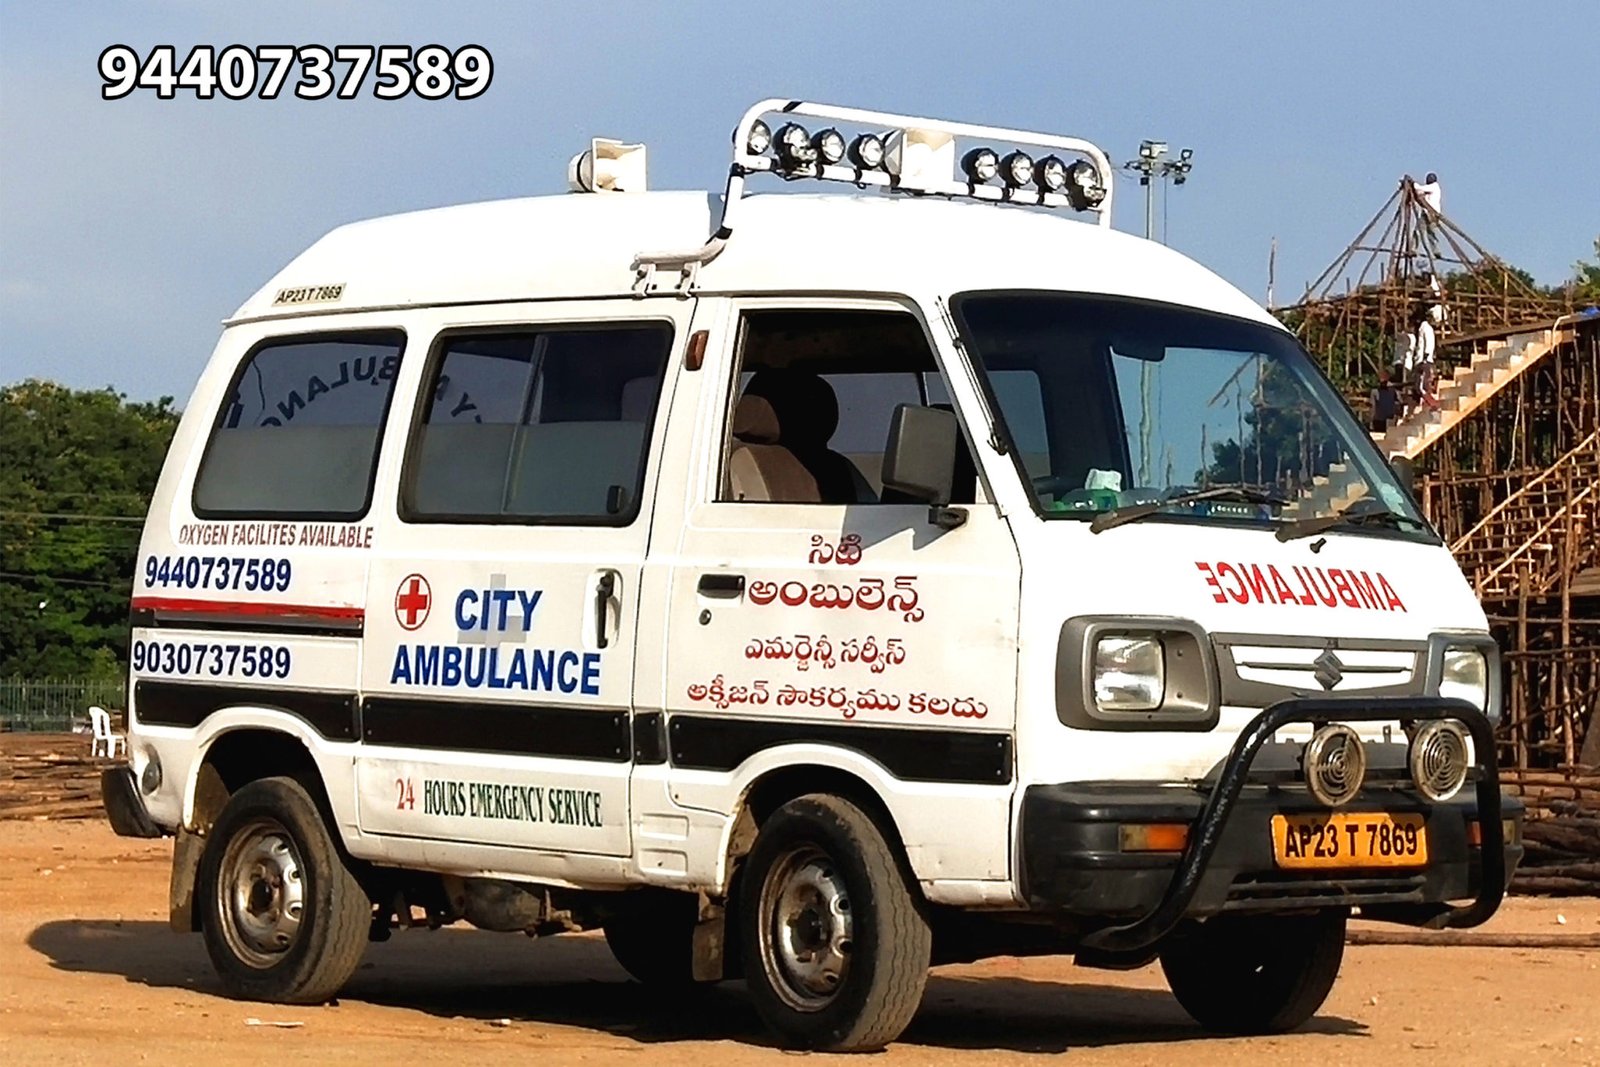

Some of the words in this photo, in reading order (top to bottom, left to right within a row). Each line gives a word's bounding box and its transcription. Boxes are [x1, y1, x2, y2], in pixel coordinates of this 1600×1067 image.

[179, 524, 230, 545] OXYGEN
[298, 525, 374, 549] AVAILABLE
[145, 555, 291, 592] 9440737589
[454, 590, 543, 632] CITY
[133, 640, 290, 679] 9030737589
[390, 645, 601, 695] AMBULANCE
[907, 691, 989, 720] కలదు
[395, 778, 415, 810] 24
[424, 780, 466, 816] HOURS
[469, 782, 545, 823] EMERGENCY
[549, 788, 603, 828] SERVICE
[1285, 824, 1339, 858] AP23
[1345, 824, 1359, 856] T
[1366, 823, 1418, 856] 7869
